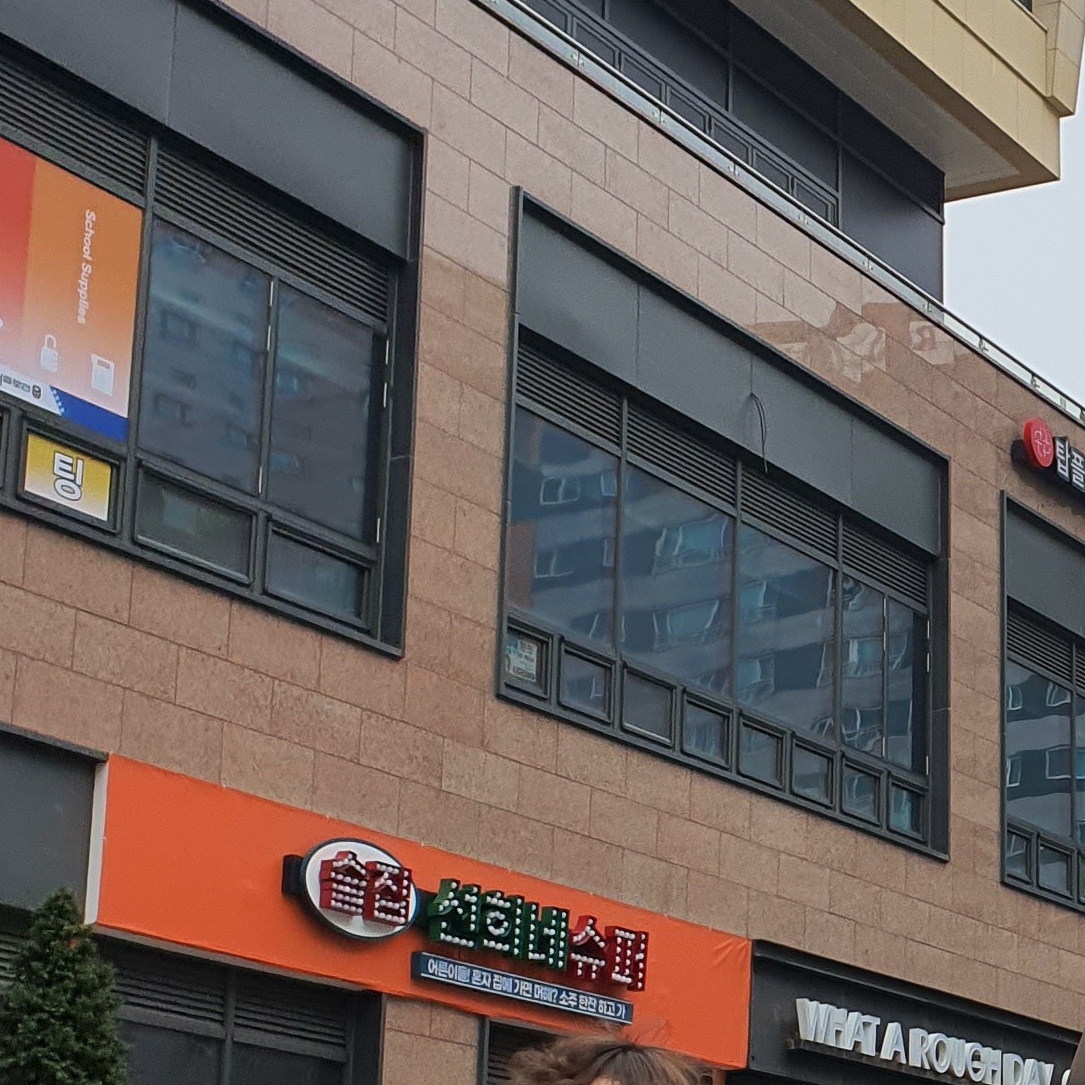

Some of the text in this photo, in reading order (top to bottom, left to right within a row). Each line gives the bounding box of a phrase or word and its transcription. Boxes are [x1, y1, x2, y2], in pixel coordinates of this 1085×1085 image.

[77, 209, 97, 325] School Supplies
[319, 850, 412, 926] 술집
[470, 971, 492, 988] 혼자
[512, 980, 533, 998] 가면
[558, 992, 578, 1008] 소주
[577, 996, 598, 1013] 한잔
[597, 1000, 617, 1016] 하고
[616, 1004, 627, 1019] 가
[795, 998, 881, 1057] WHAT
[879, 1021, 907, 1065] A
